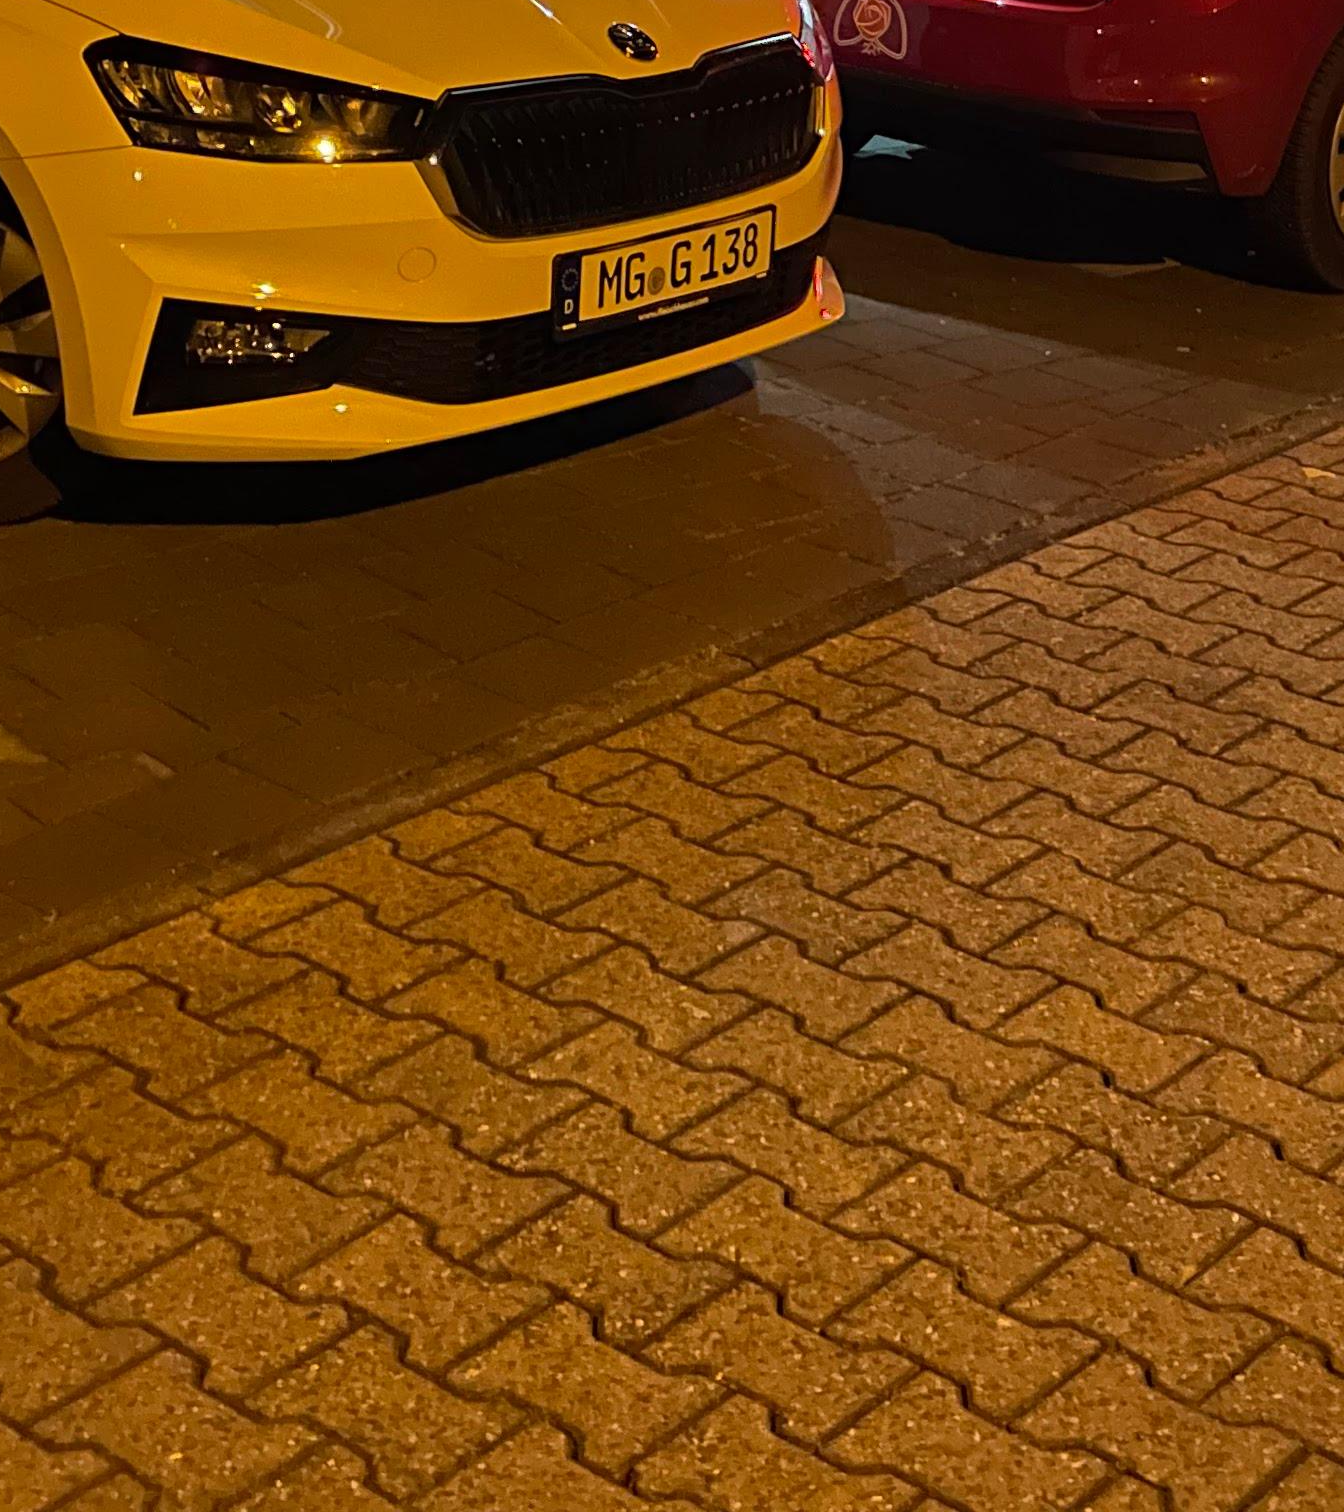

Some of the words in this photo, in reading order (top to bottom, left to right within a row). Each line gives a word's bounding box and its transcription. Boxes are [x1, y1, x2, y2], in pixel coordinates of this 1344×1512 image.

[564, 298, 574, 315] D
[598, 251, 646, 309] MG
[670, 240, 691, 289] G
[700, 223, 758, 283] 138
